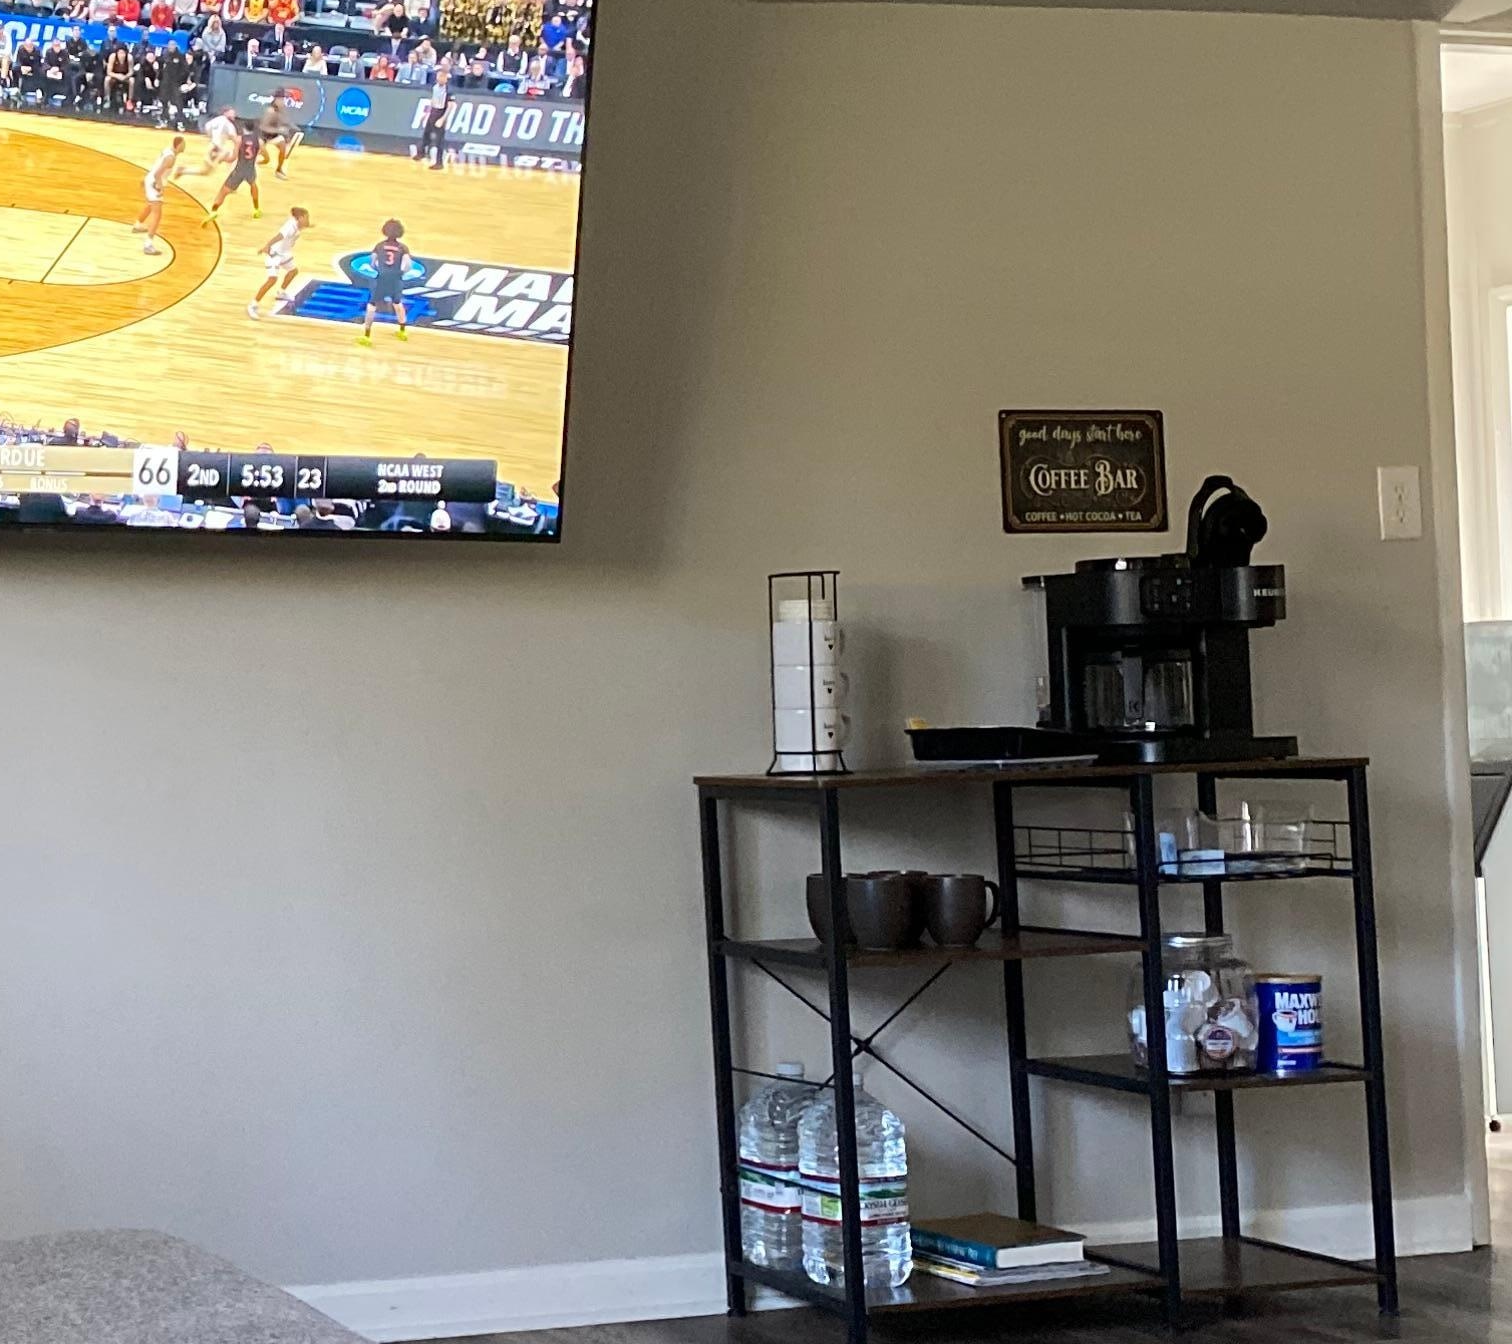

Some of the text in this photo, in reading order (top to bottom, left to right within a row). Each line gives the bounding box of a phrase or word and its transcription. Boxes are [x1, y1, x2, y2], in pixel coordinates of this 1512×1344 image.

[340, 104, 369, 117] NCAA
[503, 106, 544, 139] TO
[138, 456, 171, 485] 66
[187, 464, 220, 486] 2ND
[240, 465, 284, 487] 5:53
[297, 468, 322, 489] 23
[377, 463, 444, 478] NCAA WEST
[1029, 459, 1138, 496] COFFEE BAR
[29, 477, 68, 492] BONUS
[398, 479, 441, 494] ROUND
[1025, 511, 1143, 522] COFFEE HOT COCOA TEA
